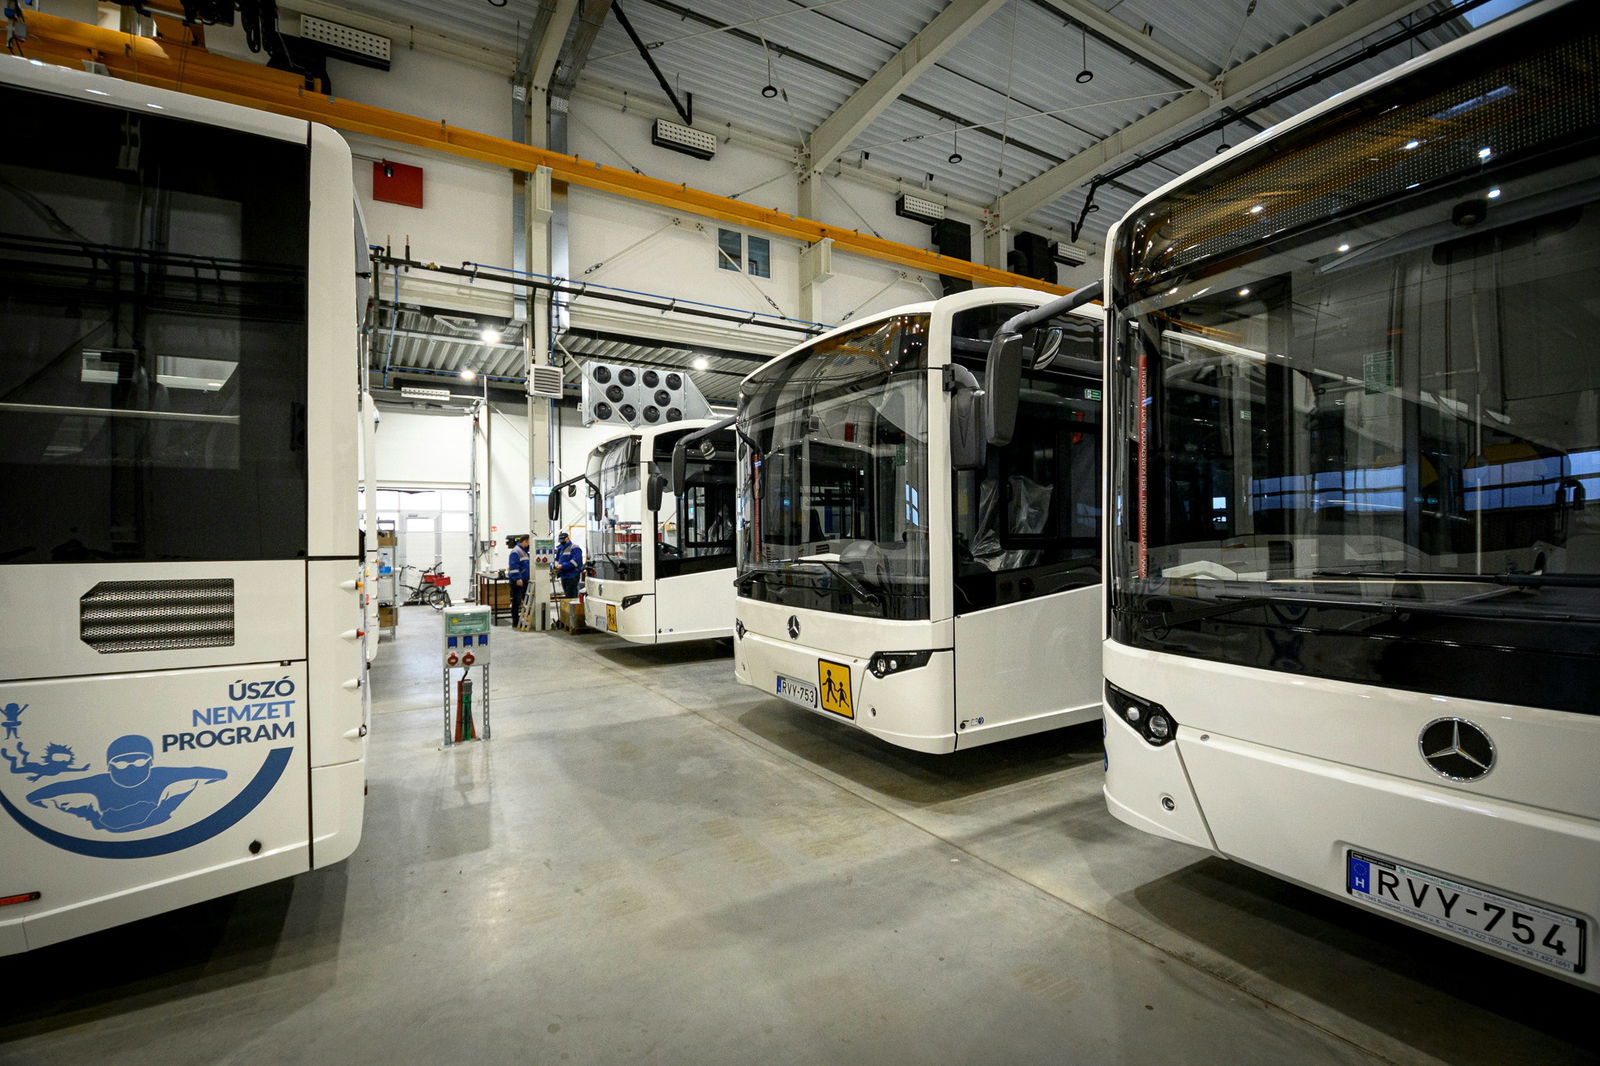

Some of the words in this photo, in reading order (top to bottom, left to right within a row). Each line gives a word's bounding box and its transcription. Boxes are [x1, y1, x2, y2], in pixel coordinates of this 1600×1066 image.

[229, 676, 295, 701] ÚSZÓ
[782, 681, 814, 703] RVY-753
[193, 700, 295, 727] NEMZET
[162, 721, 295, 752] PROGRAM
[1356, 877, 1364, 888] H
[1378, 870, 1566, 956] RVY-754
